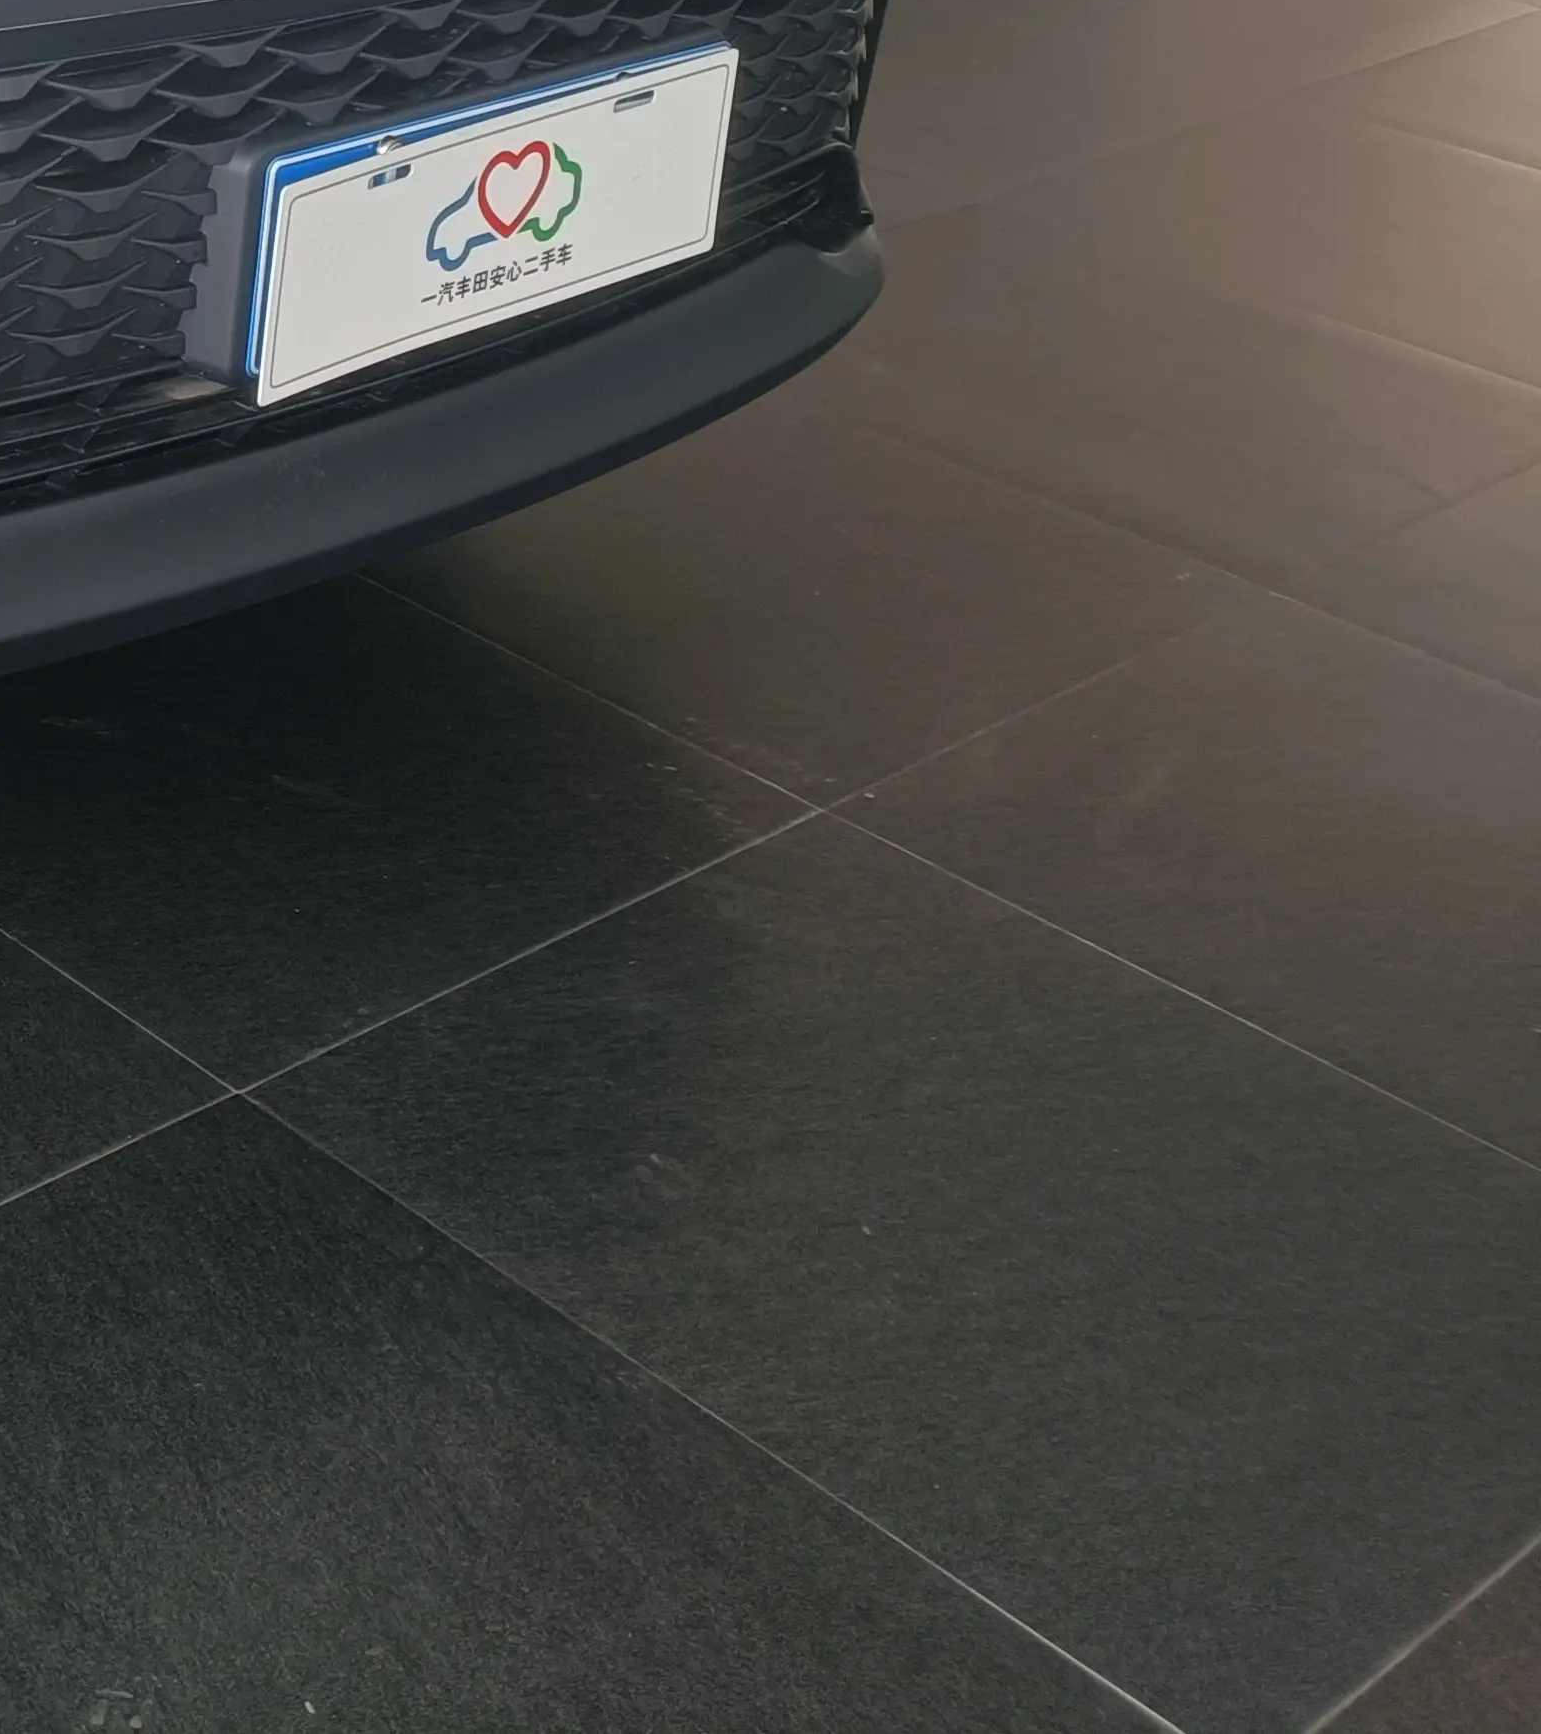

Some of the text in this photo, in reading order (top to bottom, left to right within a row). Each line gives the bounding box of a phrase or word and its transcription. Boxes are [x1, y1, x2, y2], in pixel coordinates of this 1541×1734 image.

[421, 243, 573, 306] 一汽丰田安心二手车
